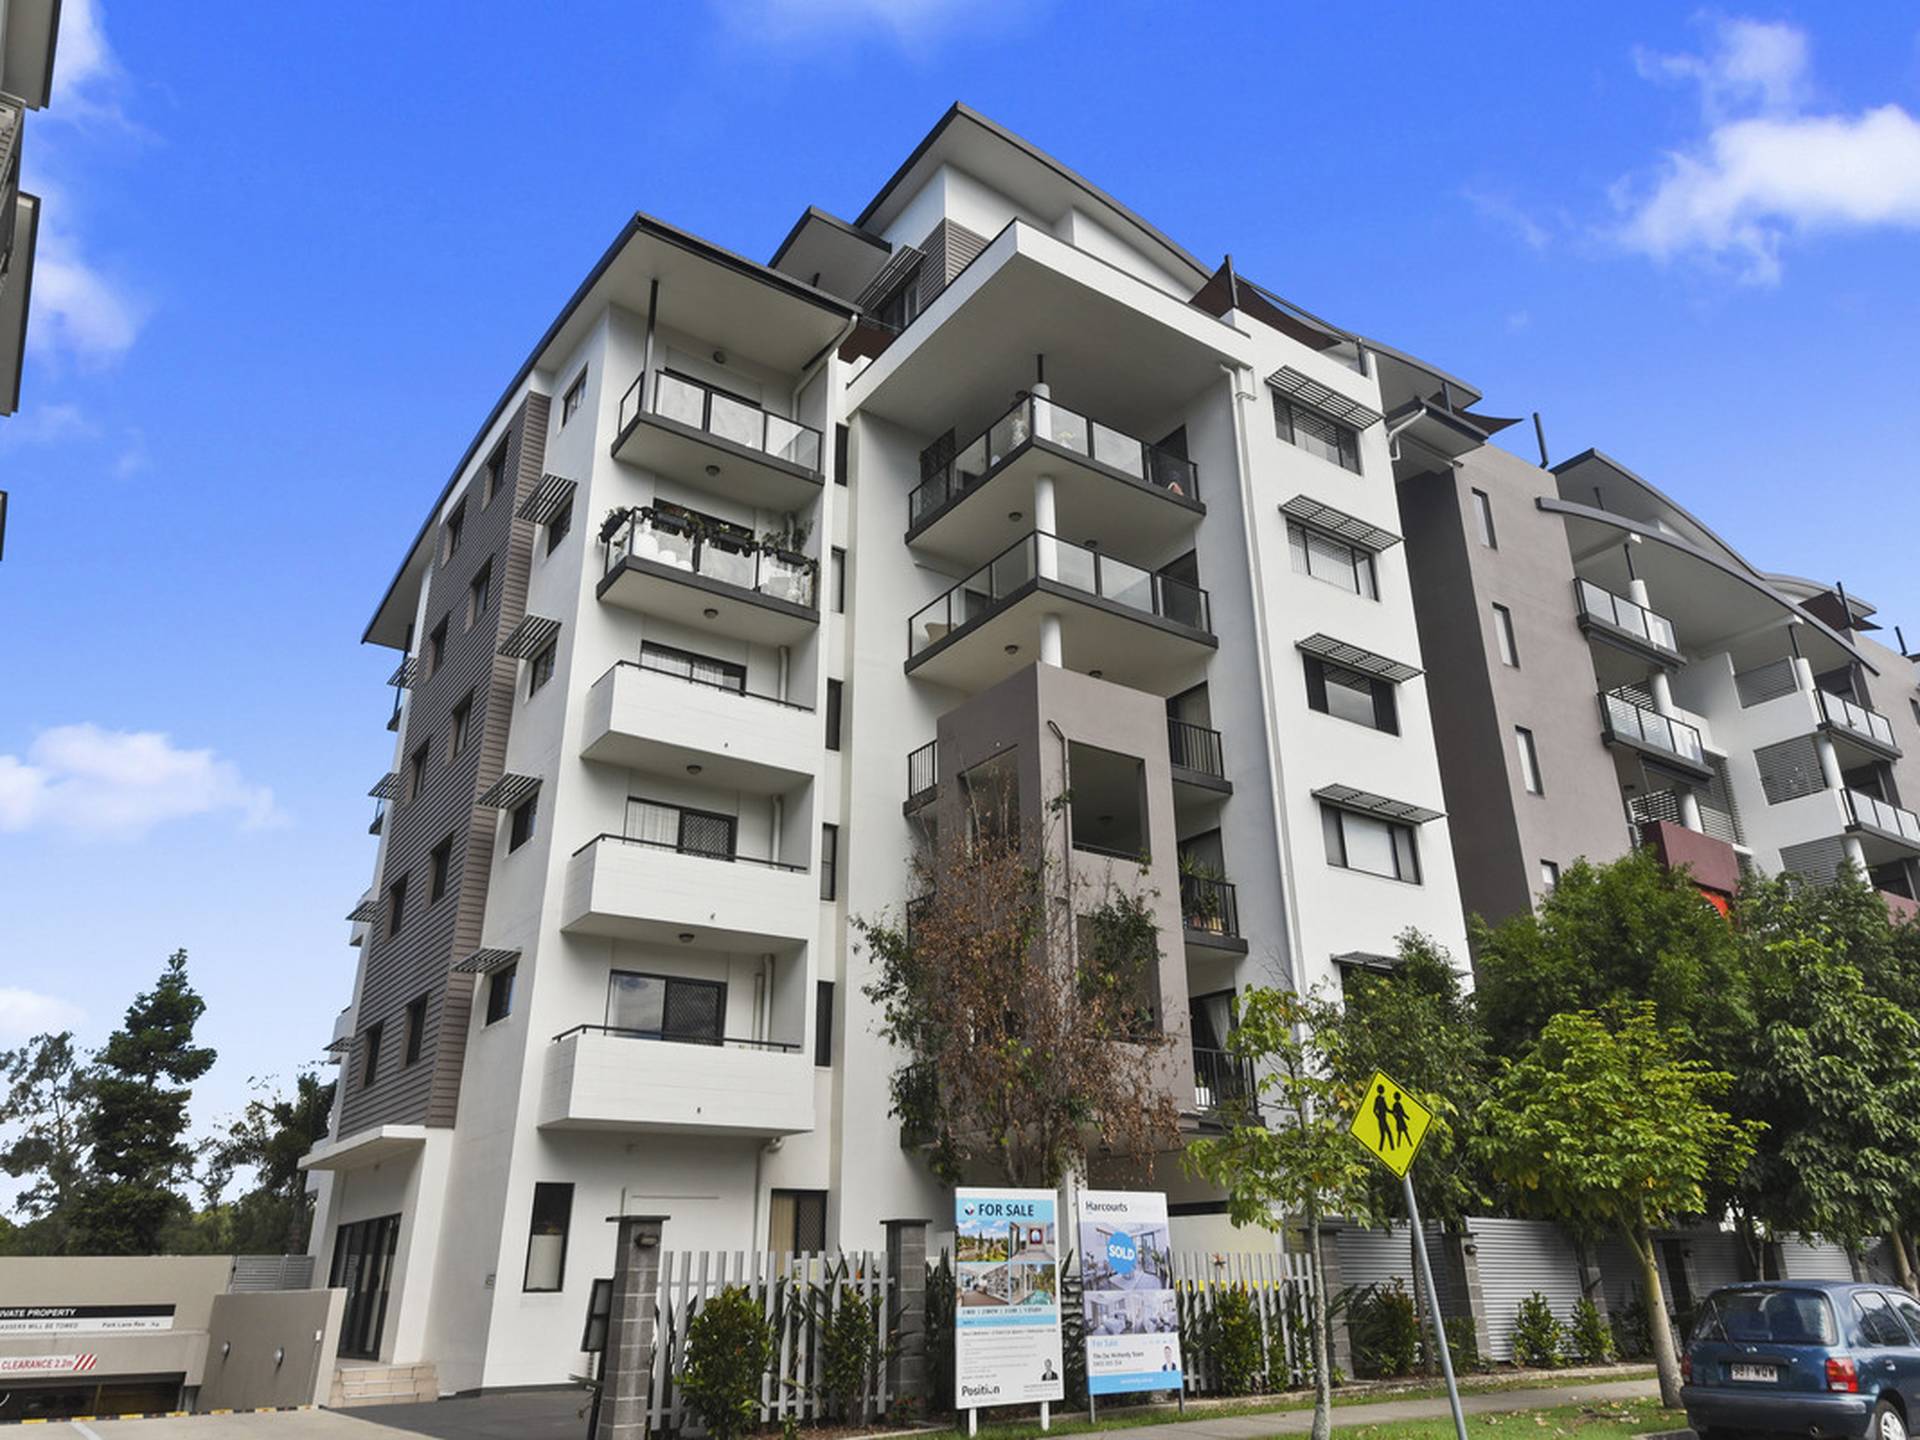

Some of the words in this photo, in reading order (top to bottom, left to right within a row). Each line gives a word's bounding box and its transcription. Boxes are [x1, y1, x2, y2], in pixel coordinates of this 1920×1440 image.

[978, 1203, 1003, 1217] FOR
[1006, 1203, 1034, 1217] SALE
[1085, 1200, 1128, 1213] Harcourts
[1108, 1243, 1136, 1261] SOLD
[26, 1308, 77, 1317] PROPERTY
[1, 1359, 52, 1370] CLEARANCE
[54, 1358, 74, 1369] 2.2m
